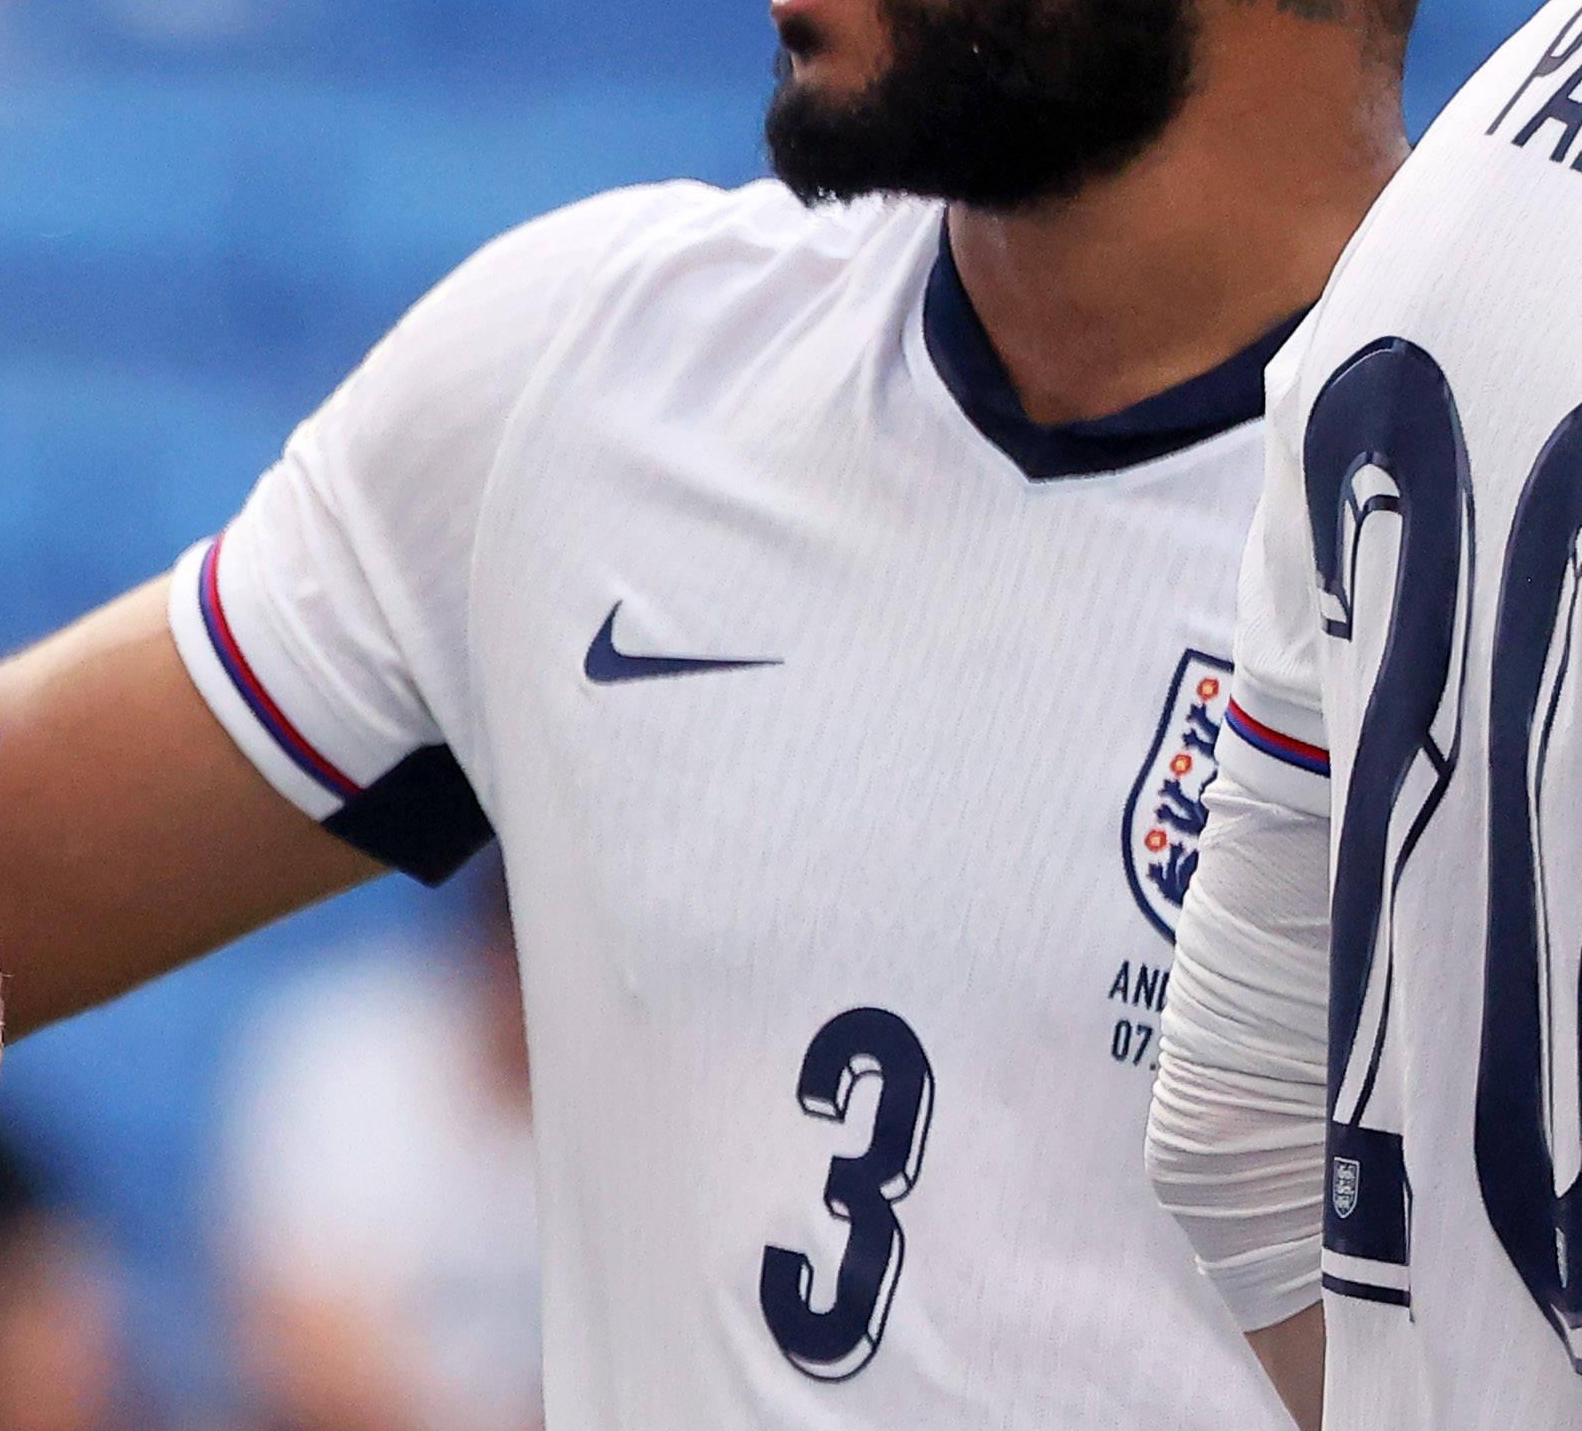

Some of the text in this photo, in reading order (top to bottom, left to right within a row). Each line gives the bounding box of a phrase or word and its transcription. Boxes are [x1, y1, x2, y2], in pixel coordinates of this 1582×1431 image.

[1485, 6, 1582, 174] PA
[1108, 958, 1170, 1013] AN
[759, 1006, 935, 1383] 3
